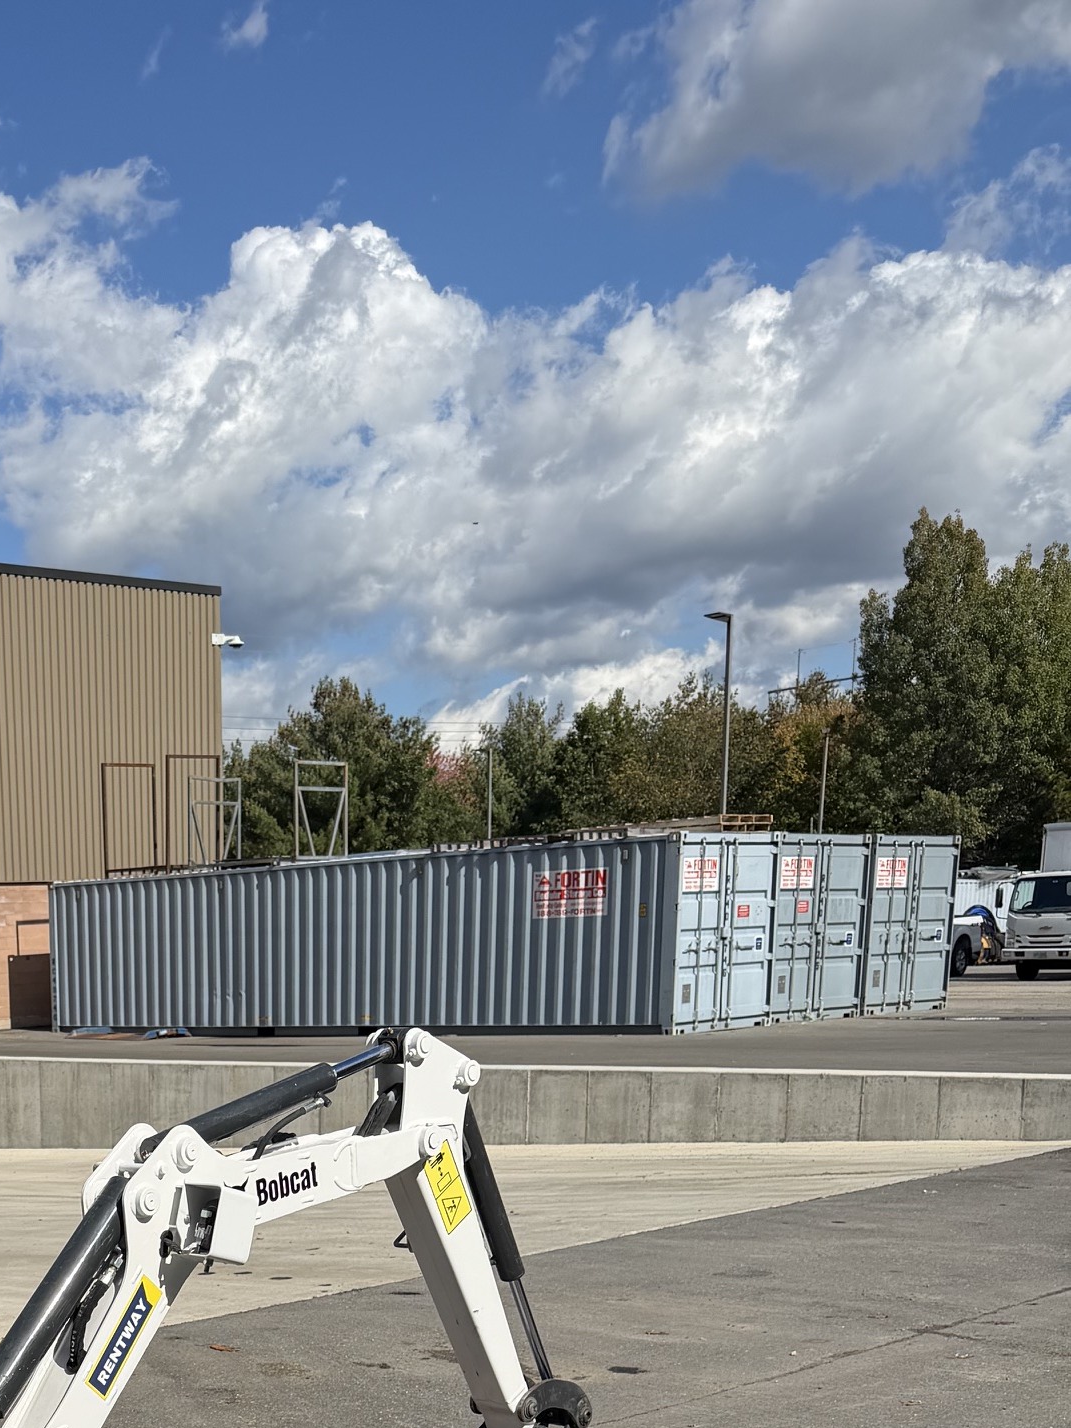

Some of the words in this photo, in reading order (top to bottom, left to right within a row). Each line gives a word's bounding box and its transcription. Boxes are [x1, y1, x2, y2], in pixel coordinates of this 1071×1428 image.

[555, 870, 607, 888] FORTIN
[256, 1162, 319, 1207] Bobcat
[97, 1297, 147, 1386] RENTWAY
